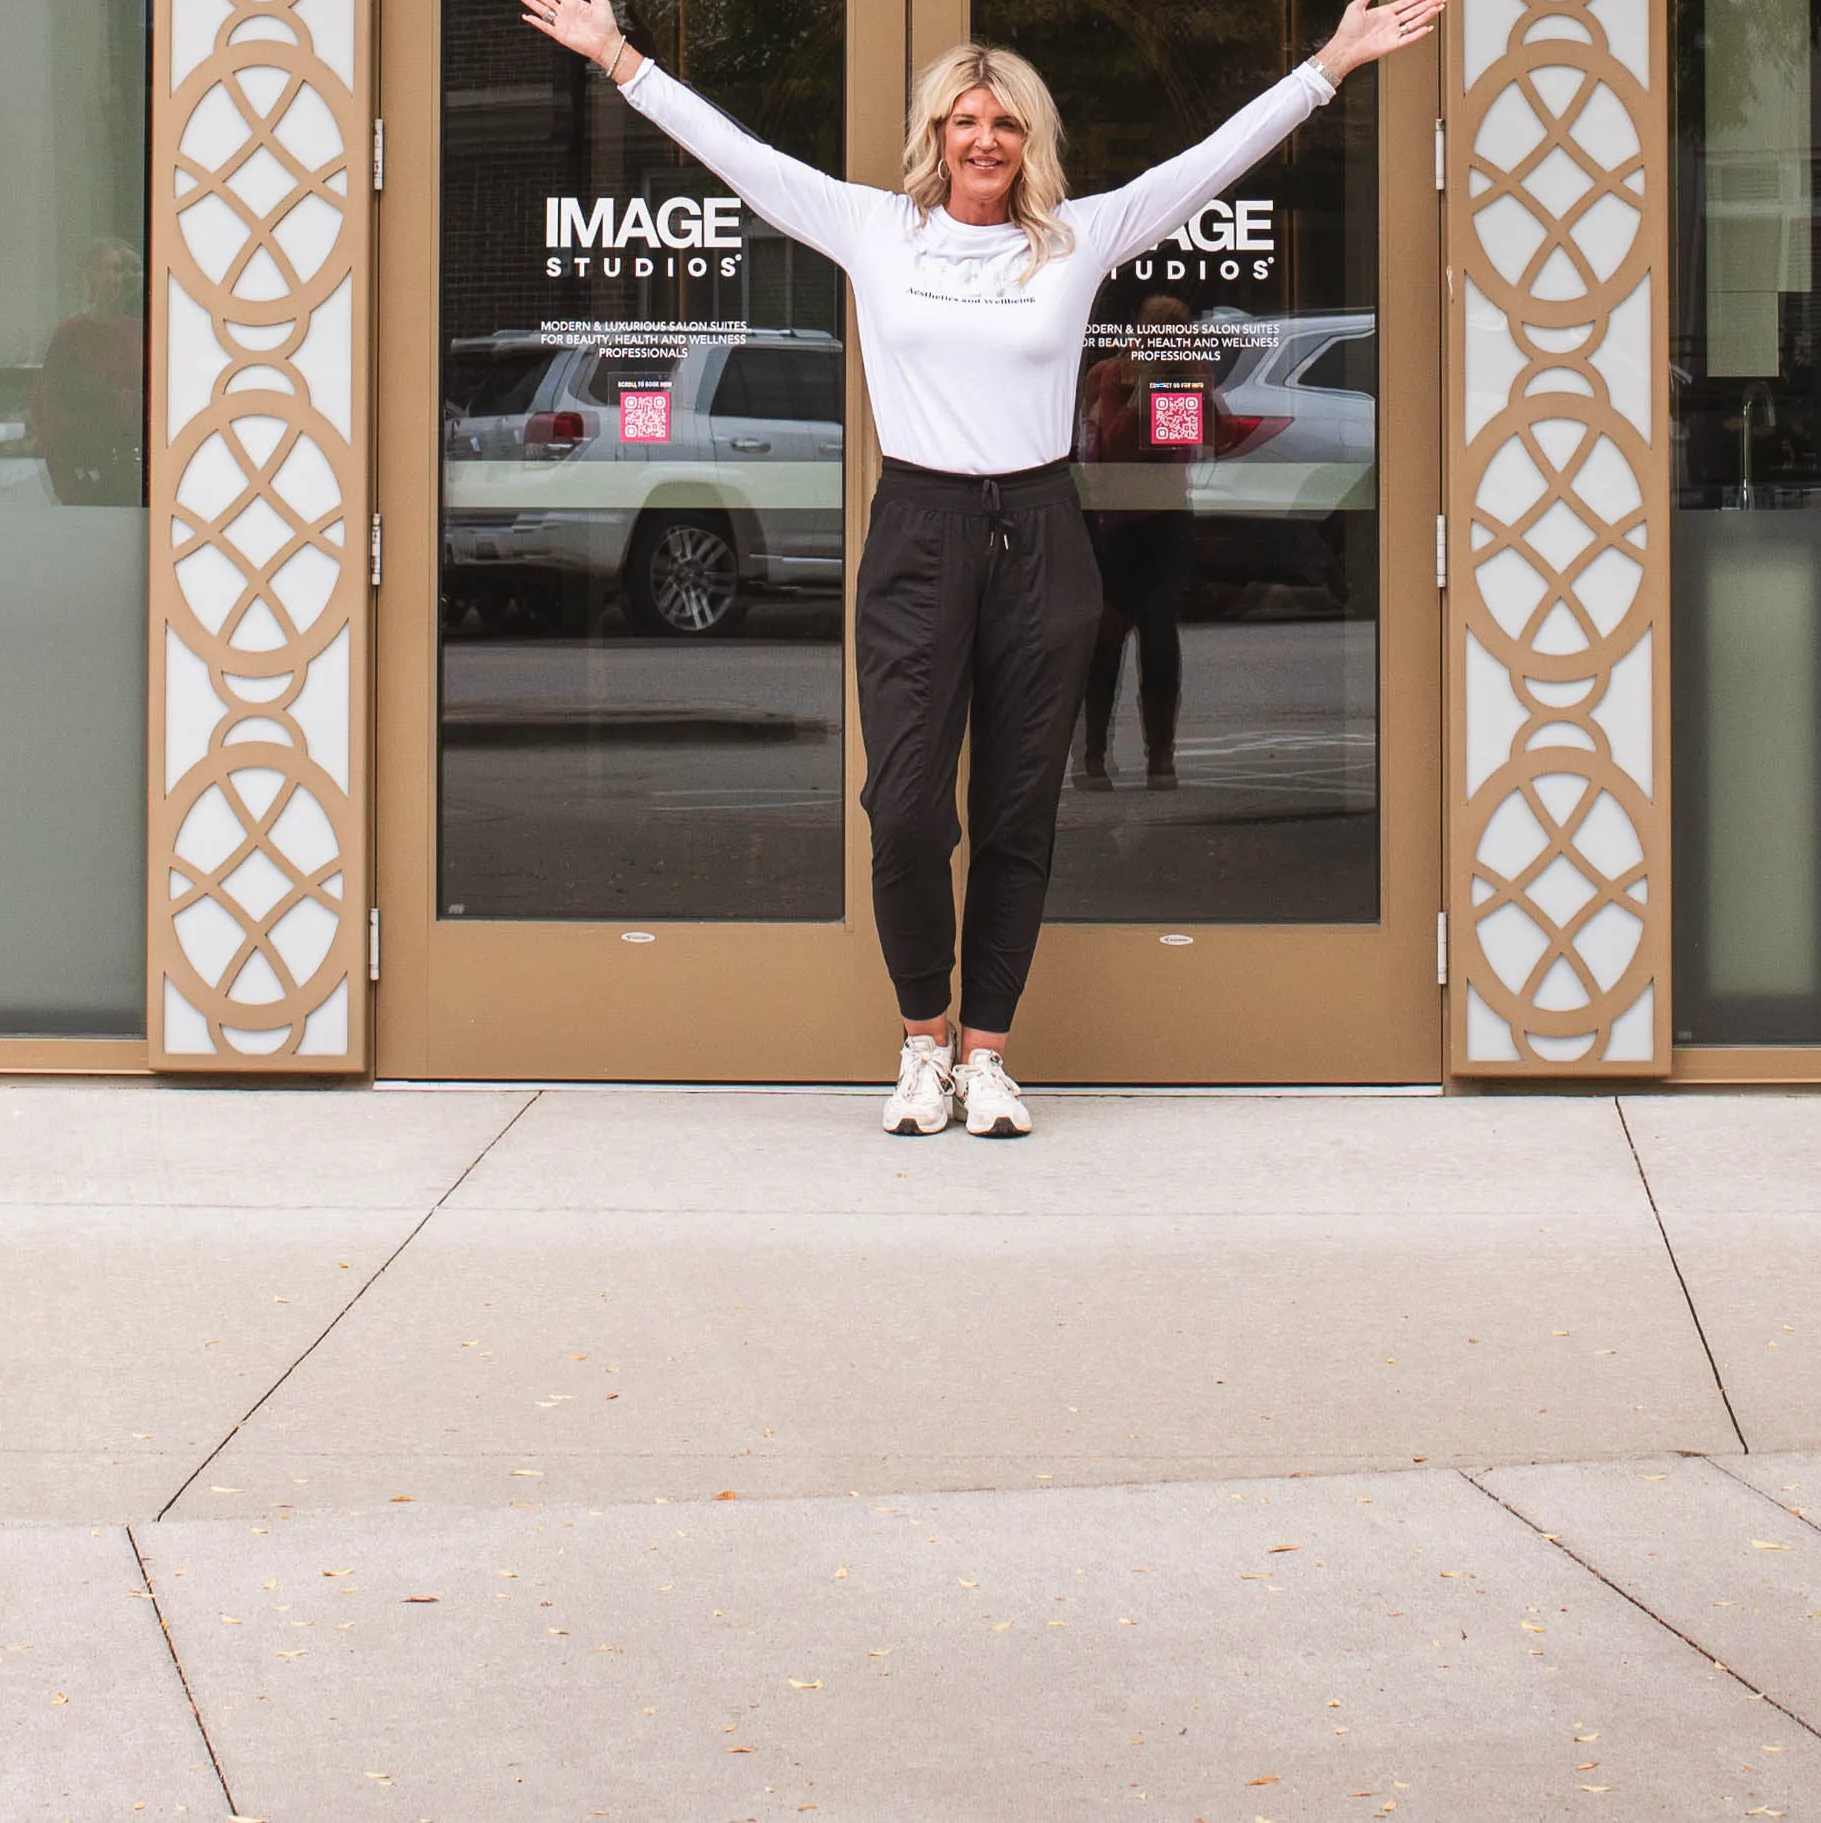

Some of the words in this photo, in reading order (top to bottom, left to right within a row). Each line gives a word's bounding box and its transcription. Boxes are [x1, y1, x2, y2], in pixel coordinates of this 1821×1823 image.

[546, 197, 742, 249] IMAGE
[541, 321, 591, 332] MODERN
[594, 321, 602, 332] &
[604, 321, 666, 332] LUXURIOUS
[669, 321, 708, 332] SALON
[710, 321, 747, 332] SUITES
[1085, 324, 1123, 335] ODERN
[1125, 324, 1134, 335] &
[1136, 324, 1199, 335] LUXURIOUS
[1201, 324, 1240, 335] SALON
[1242, 324, 1280, 335] SUITES
[541, 335, 564, 345] FOR
[566, 335, 612, 346] BEAUTY,
[615, 335, 659, 345] HEALTH
[661, 335, 687, 345] AND
[689, 335, 747, 345] WELLNESS
[1082, 338, 1096, 348] OR
[1098, 338, 1145, 350] BEAUTY,
[1147, 338, 1192, 348] HEALTH
[1194, 338, 1219, 348] AND
[1221, 338, 1280, 348] WELLNESS
[599, 348, 688, 359] PROFESSIONALS
[1131, 351, 1221, 361] PROFESSIONALS
